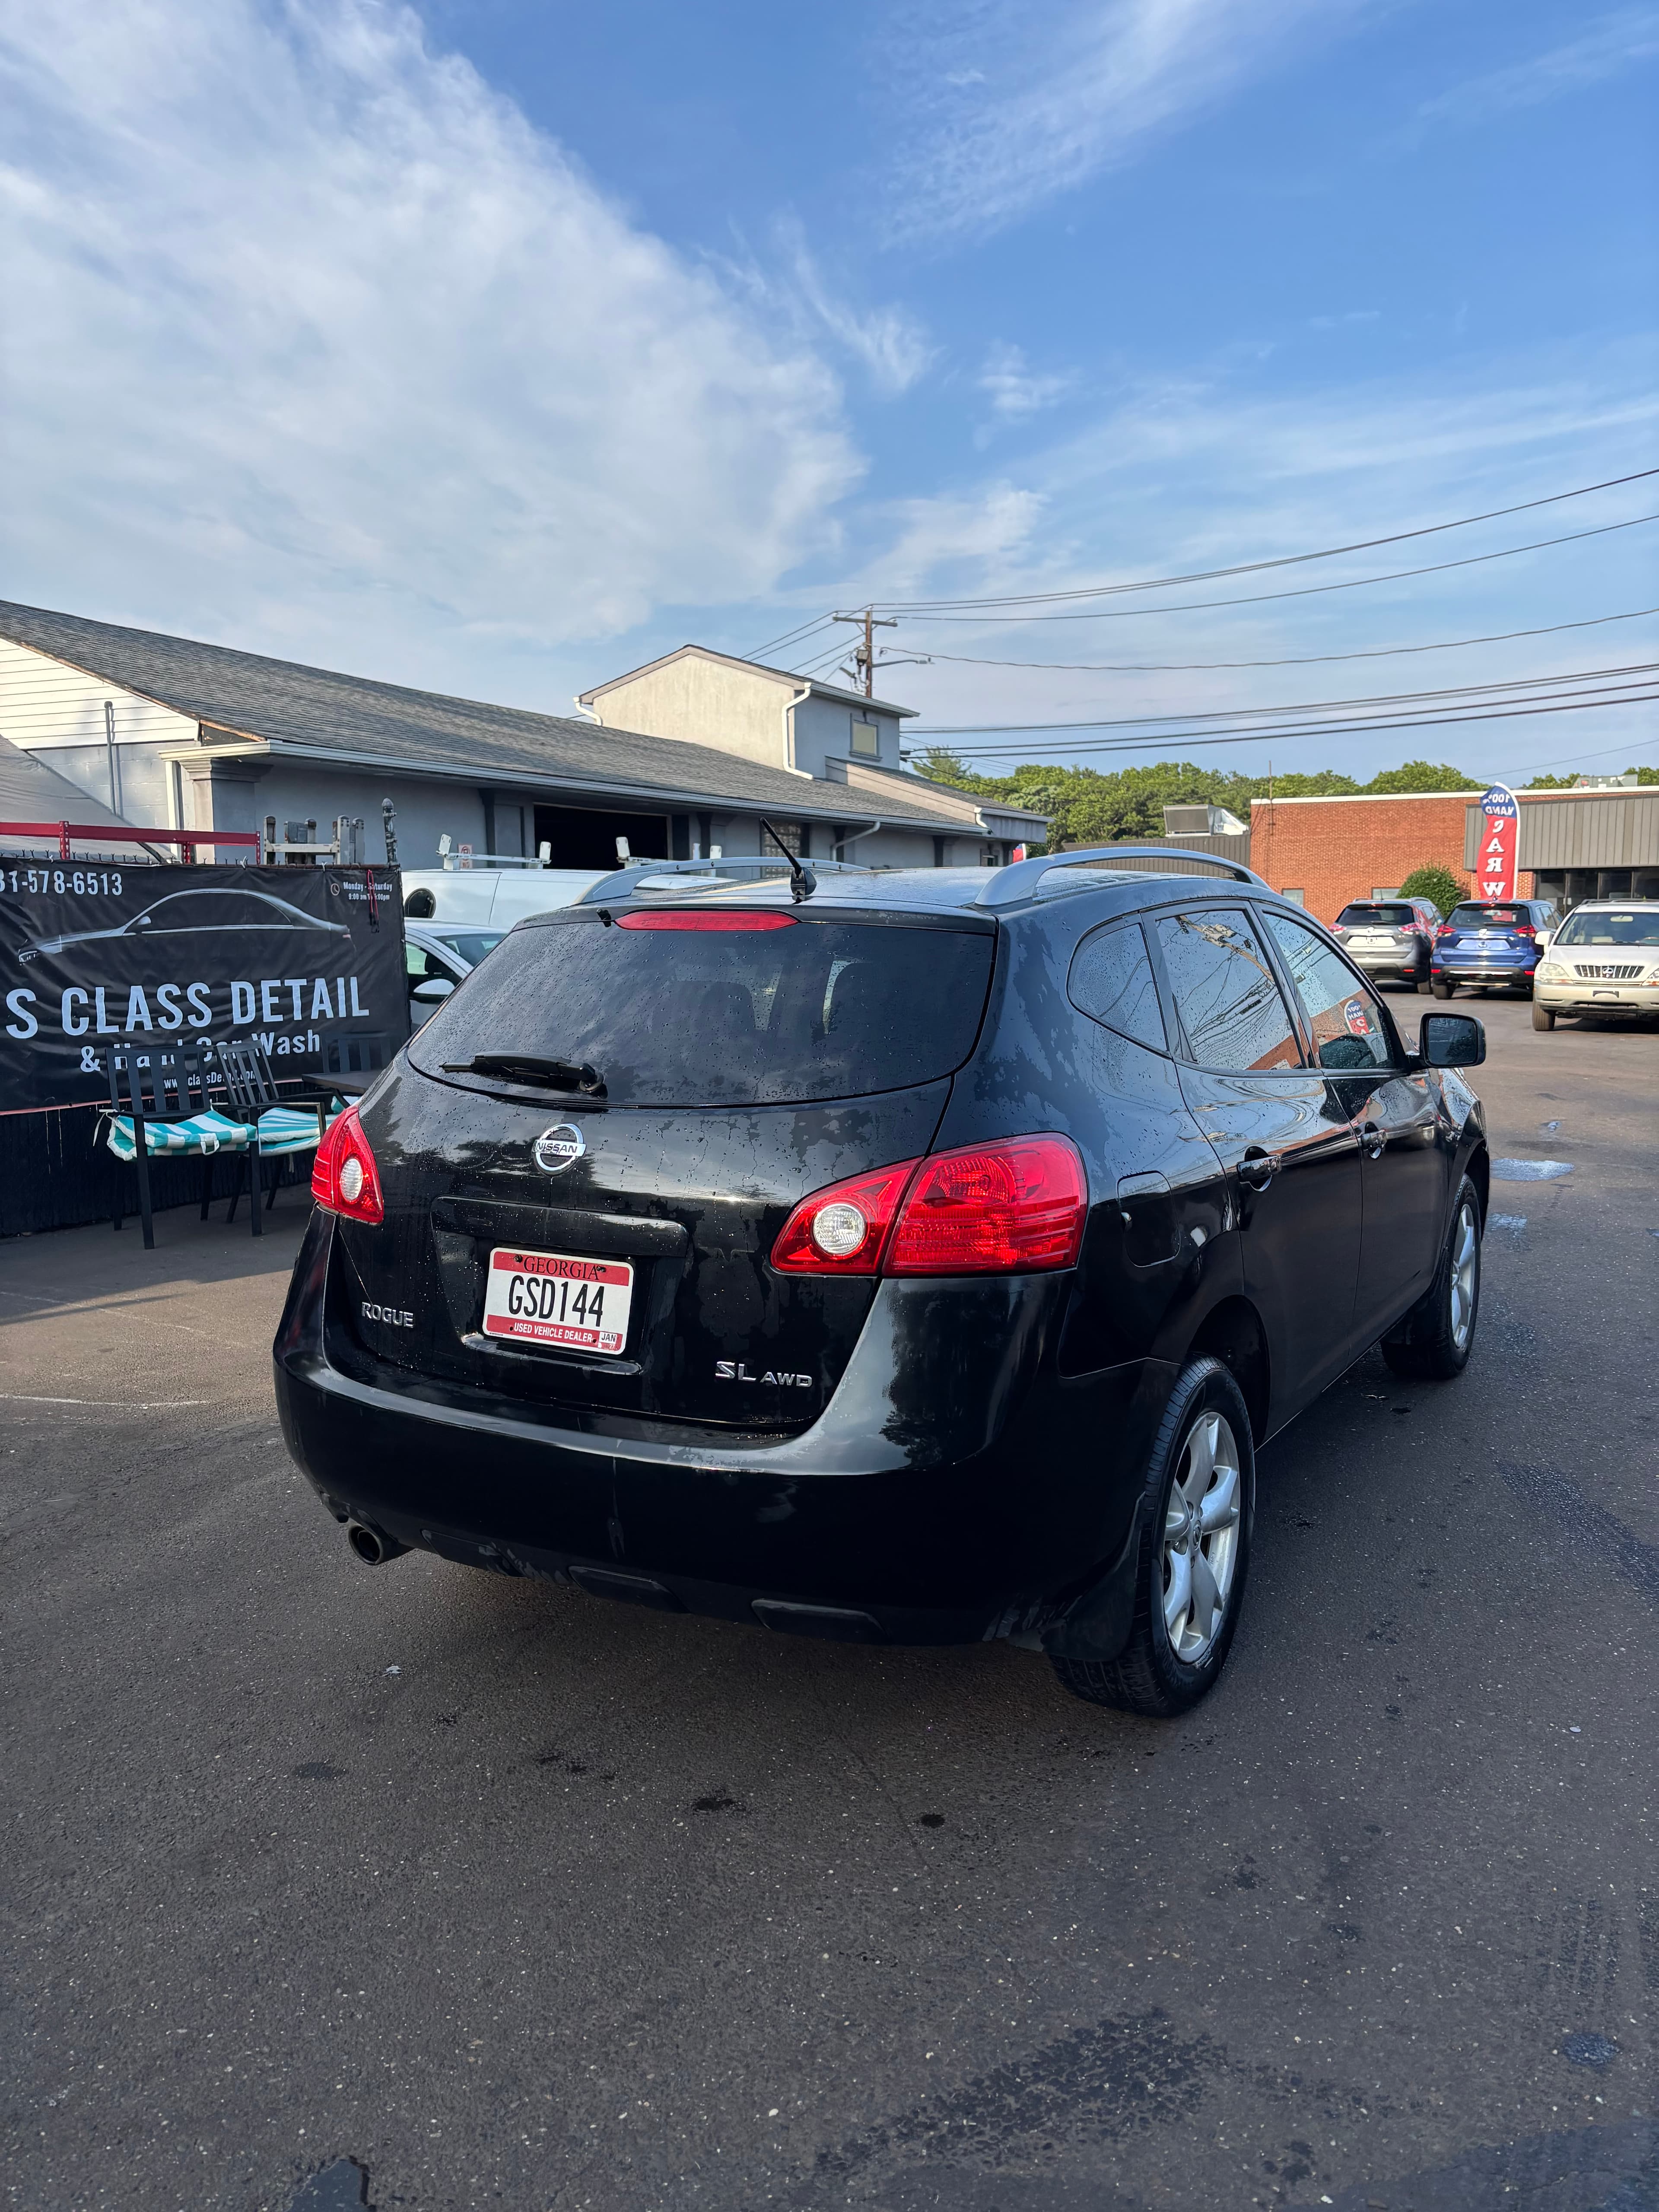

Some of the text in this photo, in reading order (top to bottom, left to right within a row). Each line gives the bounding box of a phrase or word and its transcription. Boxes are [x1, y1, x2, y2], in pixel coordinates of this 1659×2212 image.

[343, 881, 363, 891] Monday
[6, 976, 369, 1039] S CLASS DETAIL
[80, 1046, 101, 1072] &
[114, 1039, 182, 1070] Han
[251, 1029, 320, 1056] Wash
[536, 1142, 578, 1154] NISSAN
[524, 1256, 599, 1281] GEORGIA
[509, 1275, 604, 1327] GSD144
[362, 1301, 413, 1328] ROGUE
[514, 1322, 592, 1343] USED VEHICLE DEALER
[601, 1333, 616, 1342] JAN
[715, 1361, 813, 1387] SL AWD
